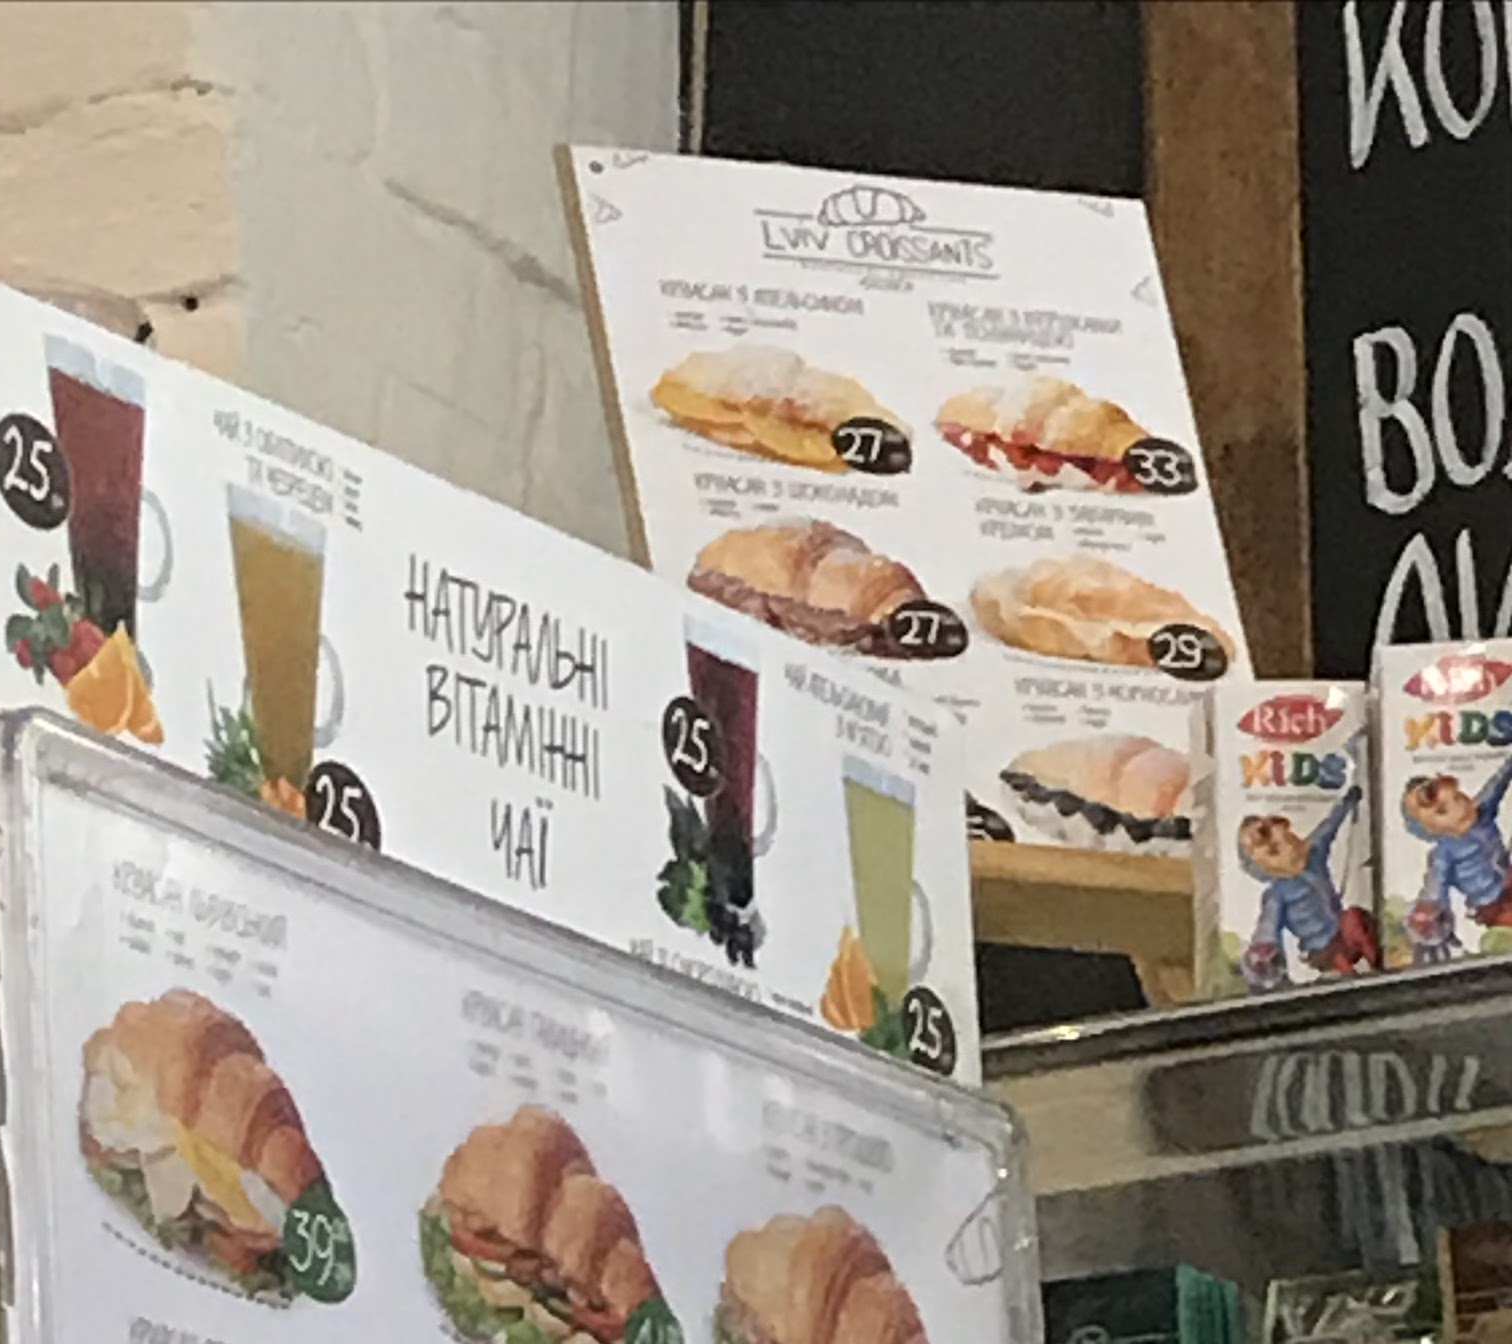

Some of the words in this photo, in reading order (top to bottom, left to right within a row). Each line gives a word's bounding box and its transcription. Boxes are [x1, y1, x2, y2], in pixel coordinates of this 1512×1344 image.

[1343, 0, 1512, 168] КО
[762, 223, 830, 253] LVIV
[847, 233, 995, 269] CROISSANTS
[837, 427, 883, 465] 27
[1353, 314, 1512, 515] ВО
[3, 424, 53, 501] 25
[1129, 449, 1184, 487] 33
[404, 553, 609, 711] НАТУРАЛЬНІ
[896, 611, 941, 646] 27
[1158, 636, 1202, 669] 29
[426, 663, 602, 802] ВІТАМІННІ
[670, 700, 712, 772] 25
[1252, 704, 1328, 734] Rich
[315, 774, 364, 842] 25
[490, 797, 554, 891] ЧАЇ
[909, 1000, 944, 1061] 25
